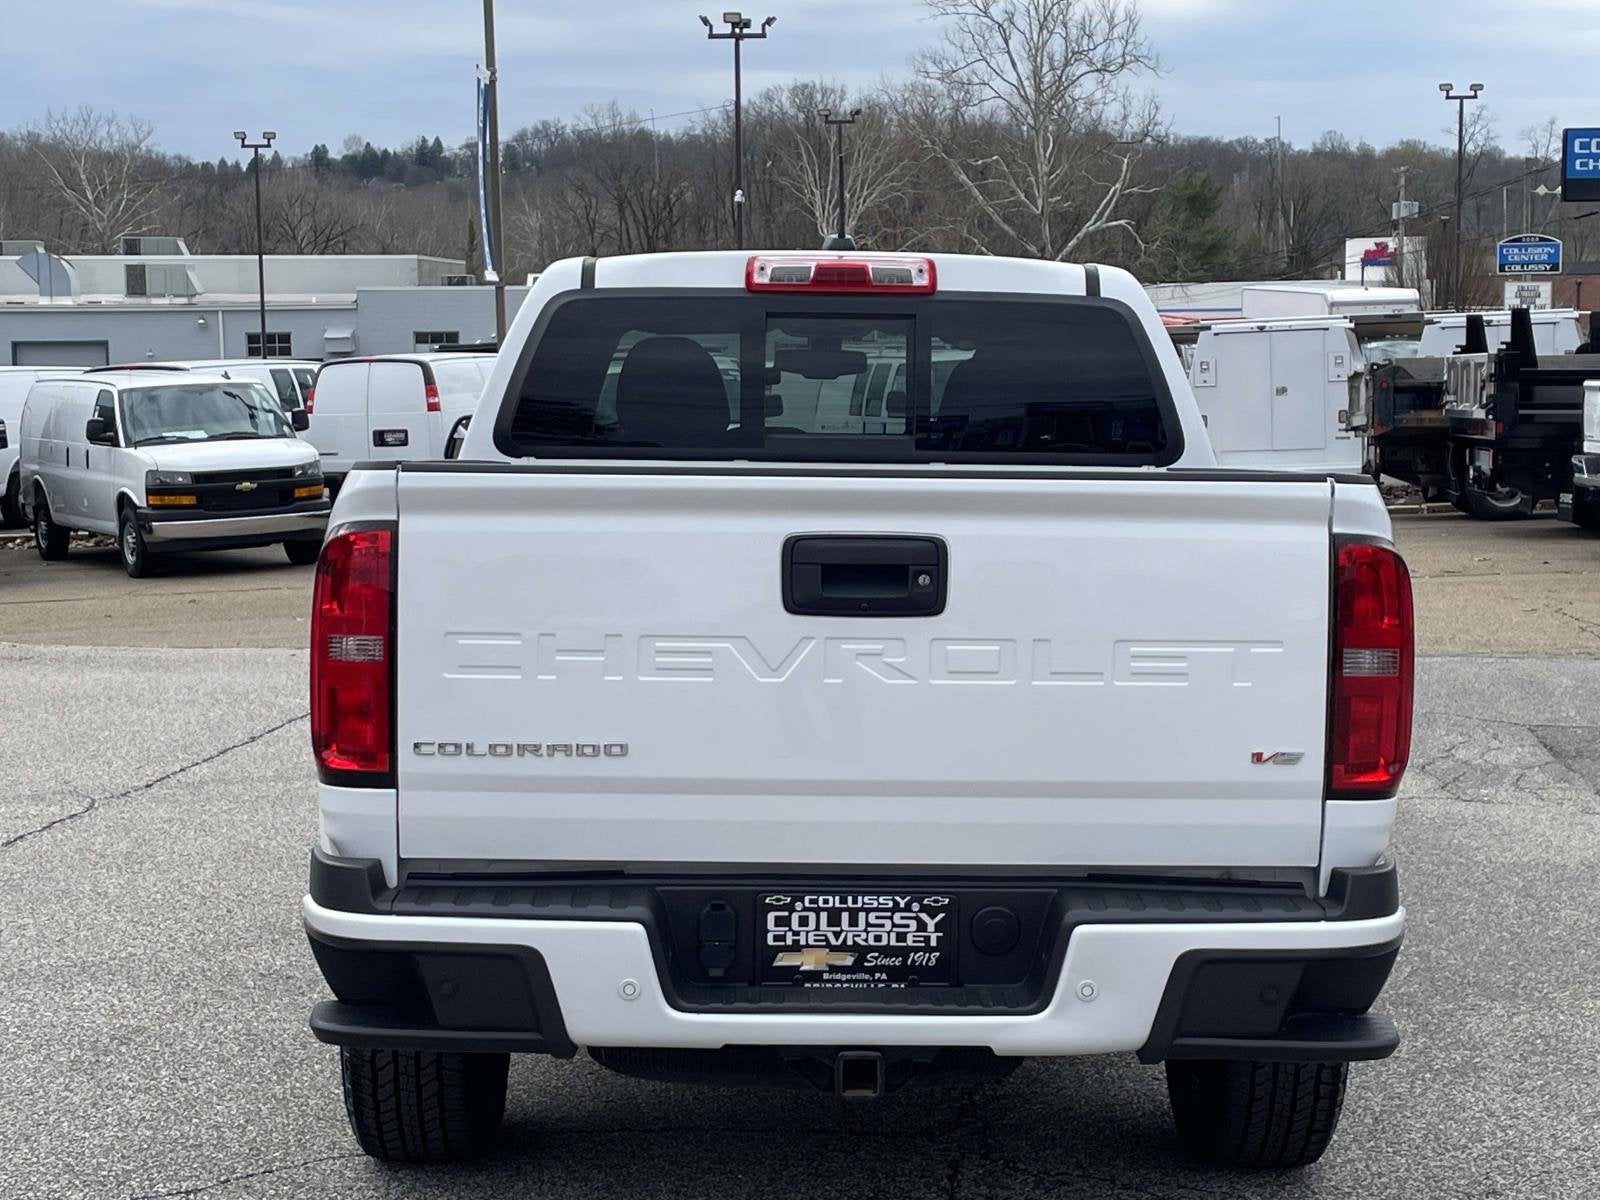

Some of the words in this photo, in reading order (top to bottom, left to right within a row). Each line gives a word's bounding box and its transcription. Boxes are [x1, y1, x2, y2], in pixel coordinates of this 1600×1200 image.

[1503, 247, 1555, 255] COLLISION
[443, 632, 1284, 687] CHEVROLET
[413, 741, 628, 758] COLORADO
[804, 896, 911, 908] COLUSSY
[767, 911, 946, 932] COLUSSY
[767, 931, 944, 946] CHEVROLET
[864, 952, 903, 966] Since
[907, 952, 940, 967] 1918
[823, 972, 873, 981] Bridgeville,
[874, 972, 888, 980] PA
